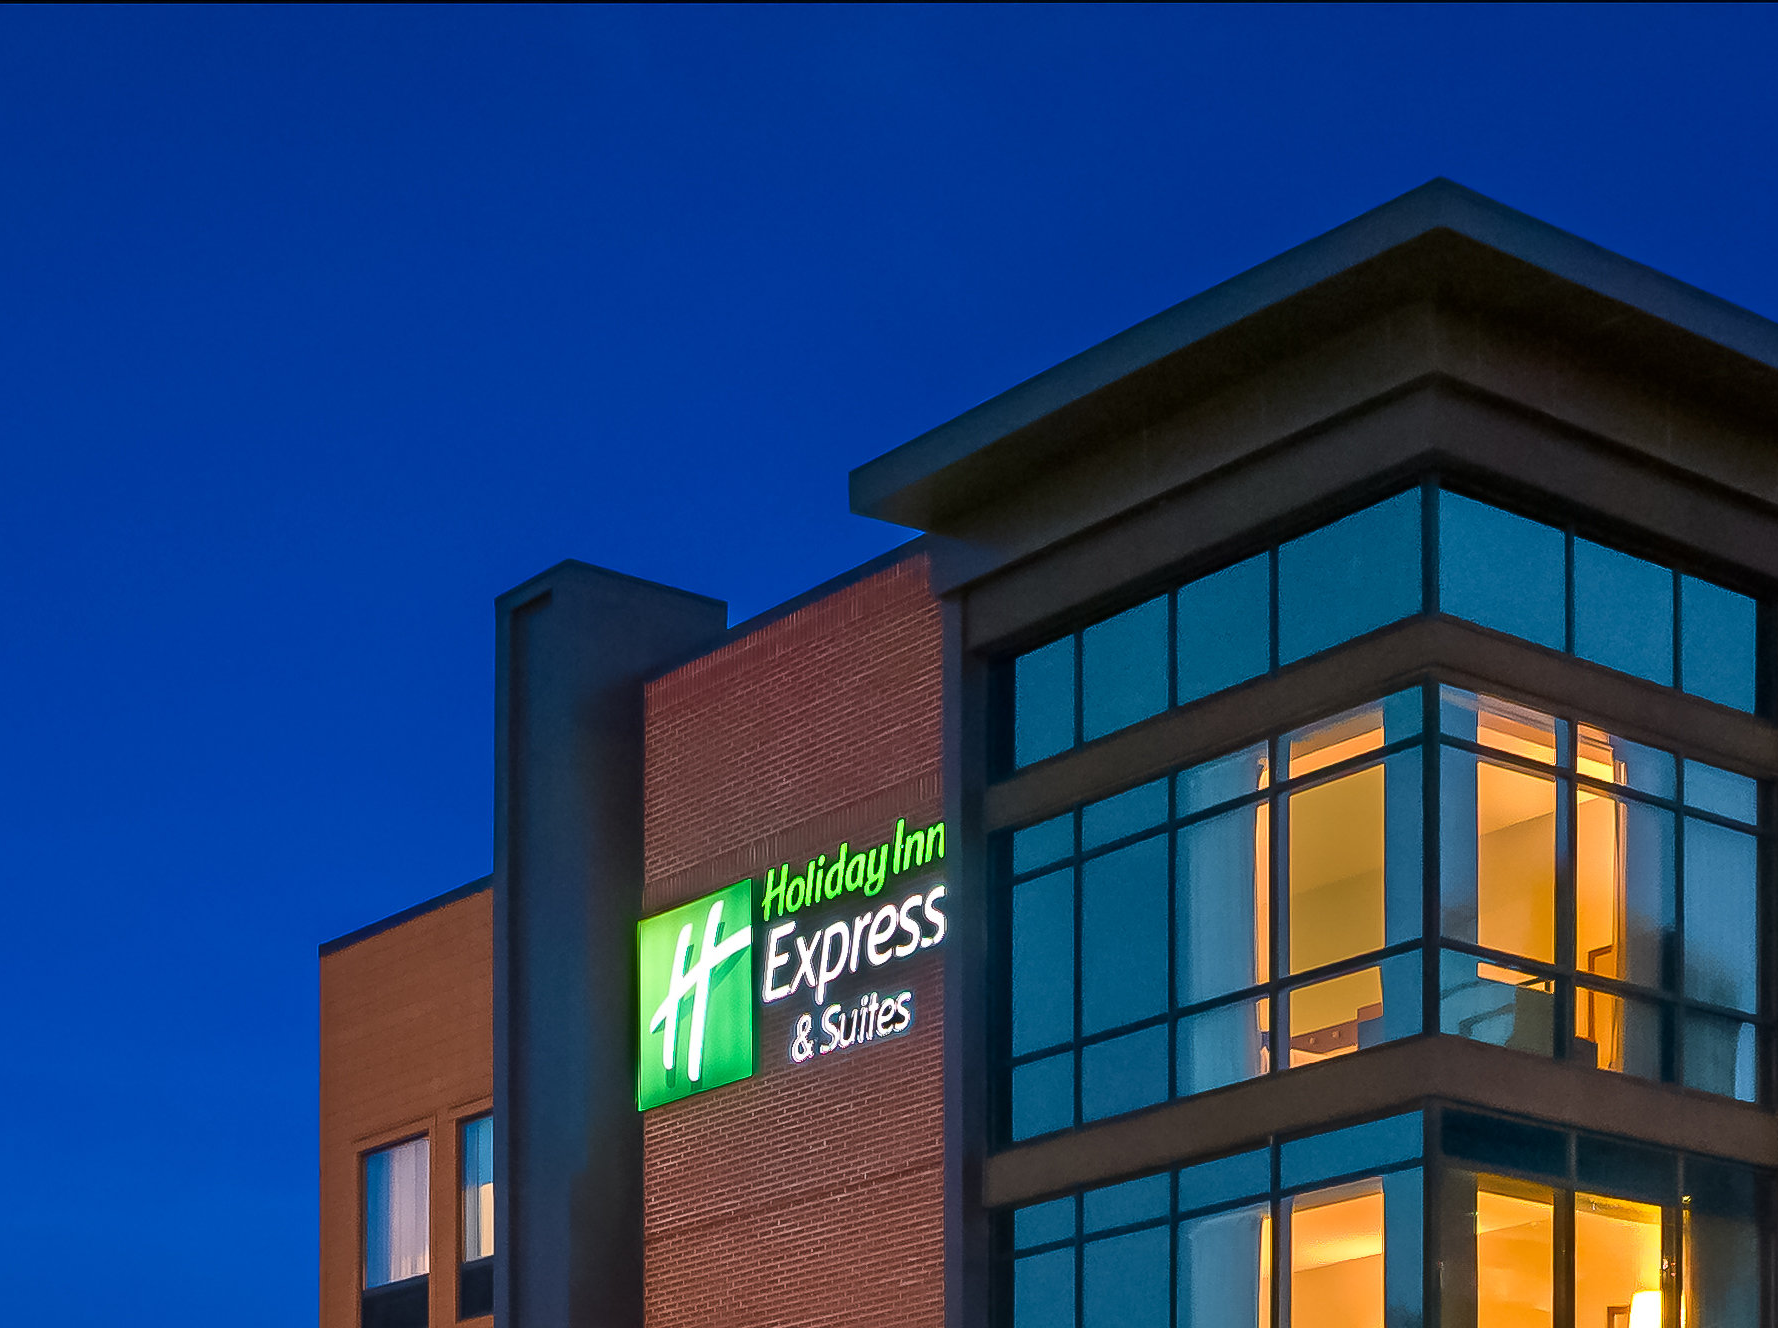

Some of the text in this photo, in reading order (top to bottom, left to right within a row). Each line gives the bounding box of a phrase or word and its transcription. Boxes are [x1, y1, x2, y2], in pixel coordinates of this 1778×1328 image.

[761, 818, 946, 922] Holiday Inn
[760, 884, 947, 1005] Express
[790, 991, 912, 1063] & Suites
